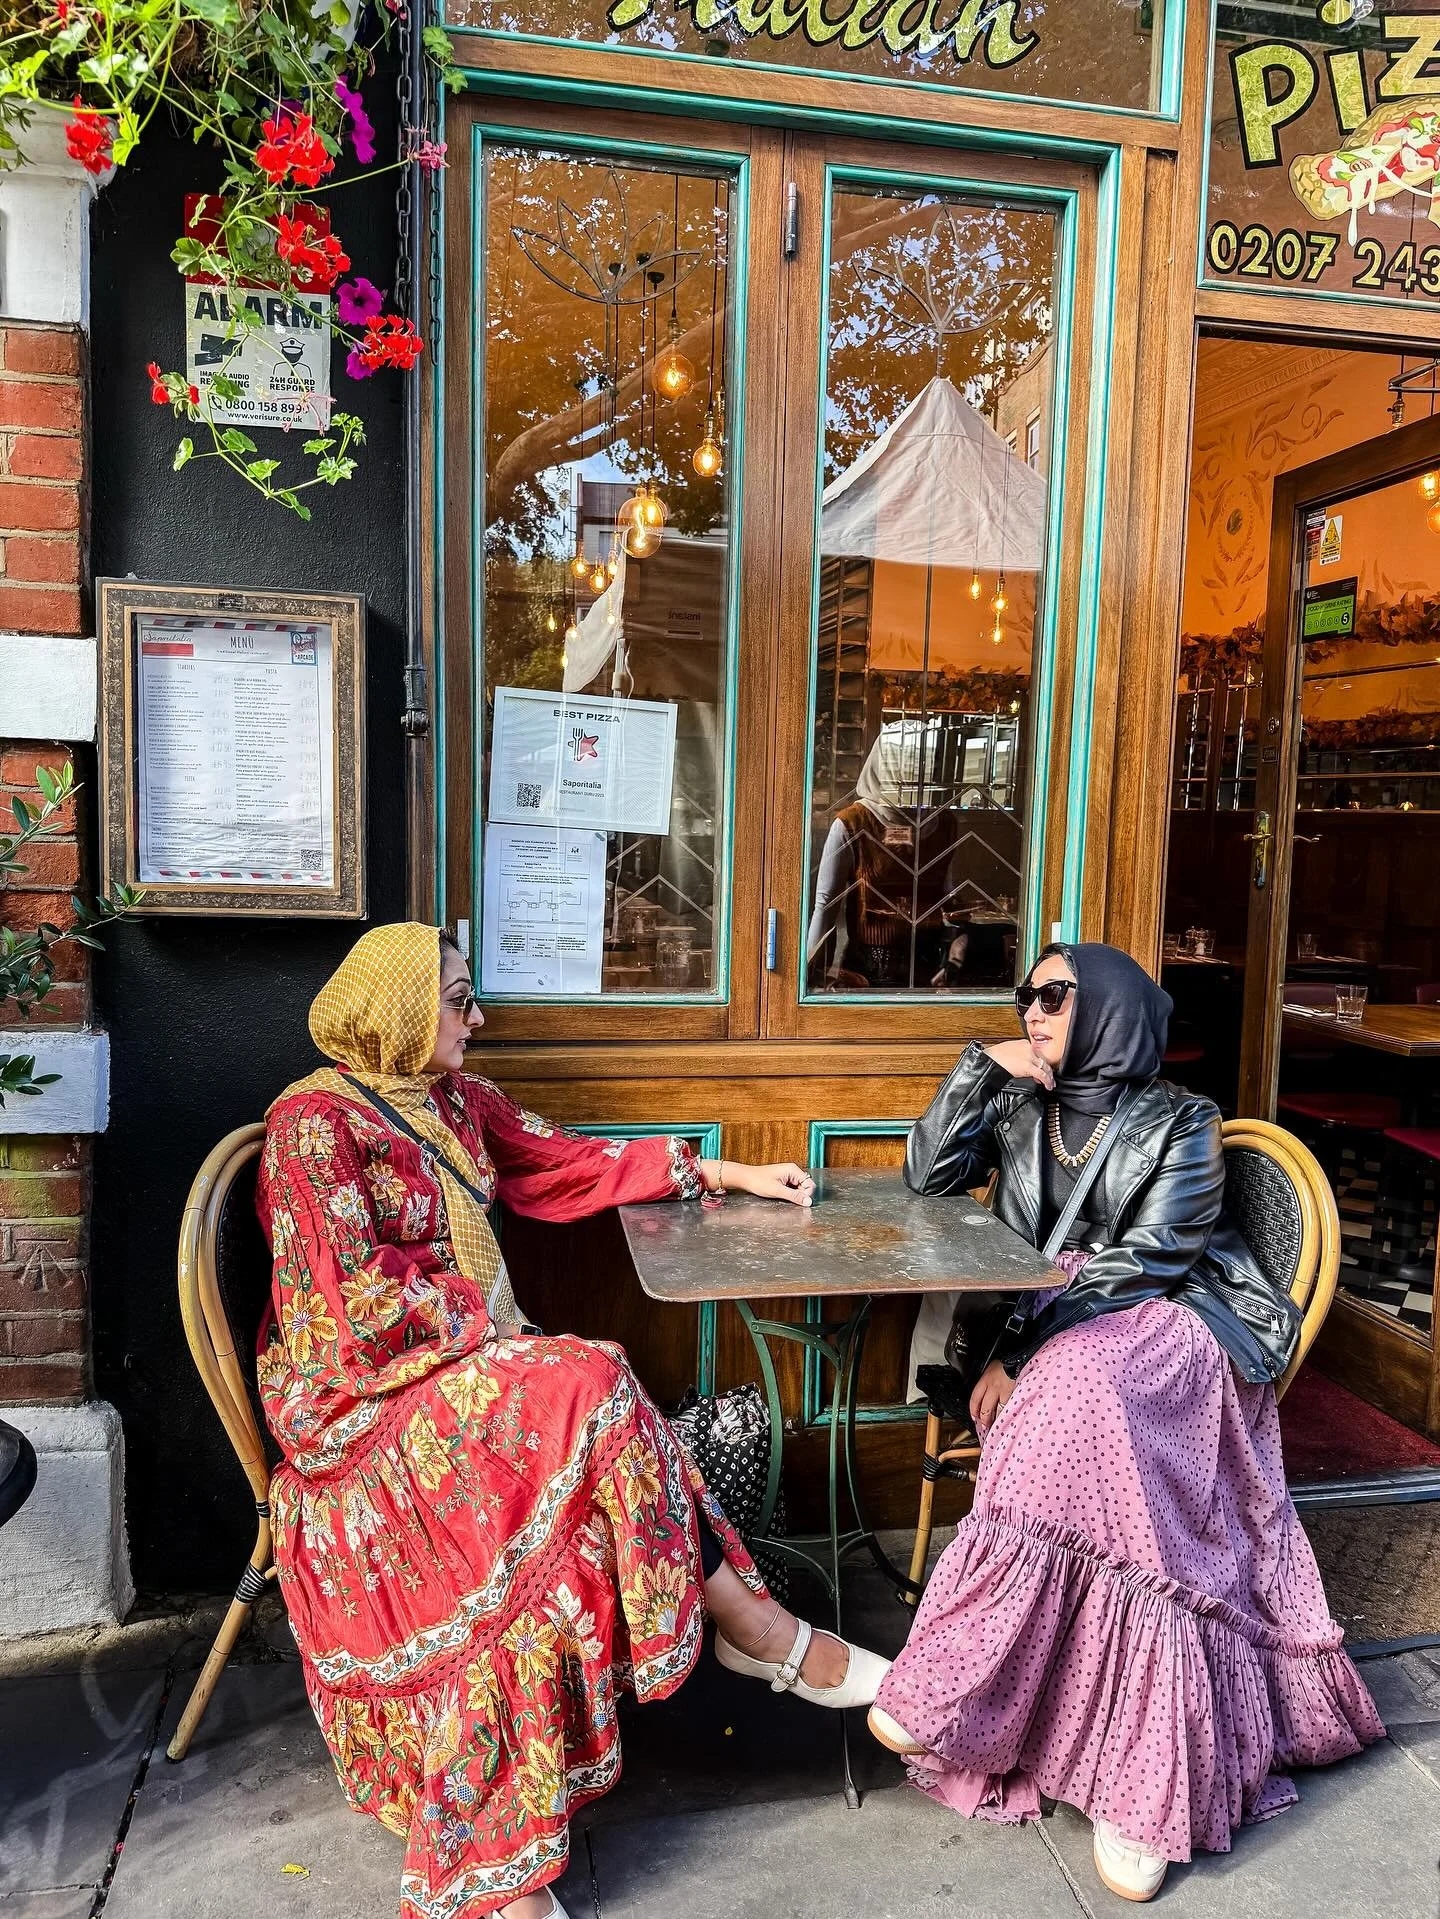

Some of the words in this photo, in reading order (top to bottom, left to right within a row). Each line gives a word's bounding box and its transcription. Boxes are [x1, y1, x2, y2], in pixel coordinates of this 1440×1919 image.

[1207, 220, 1341, 284] 0207
[1352, 237, 1440, 297] 243
[194, 292, 322, 330] ALARM
[200, 377, 250, 388] REING
[269, 384, 315, 393] RESPONSE
[225, 399, 255, 411] 0800
[258, 401, 278, 412] 158
[553, 709, 584, 719] BEST
[586, 712, 621, 723] PIZZA
[562, 779, 602, 790] Saporitalia
